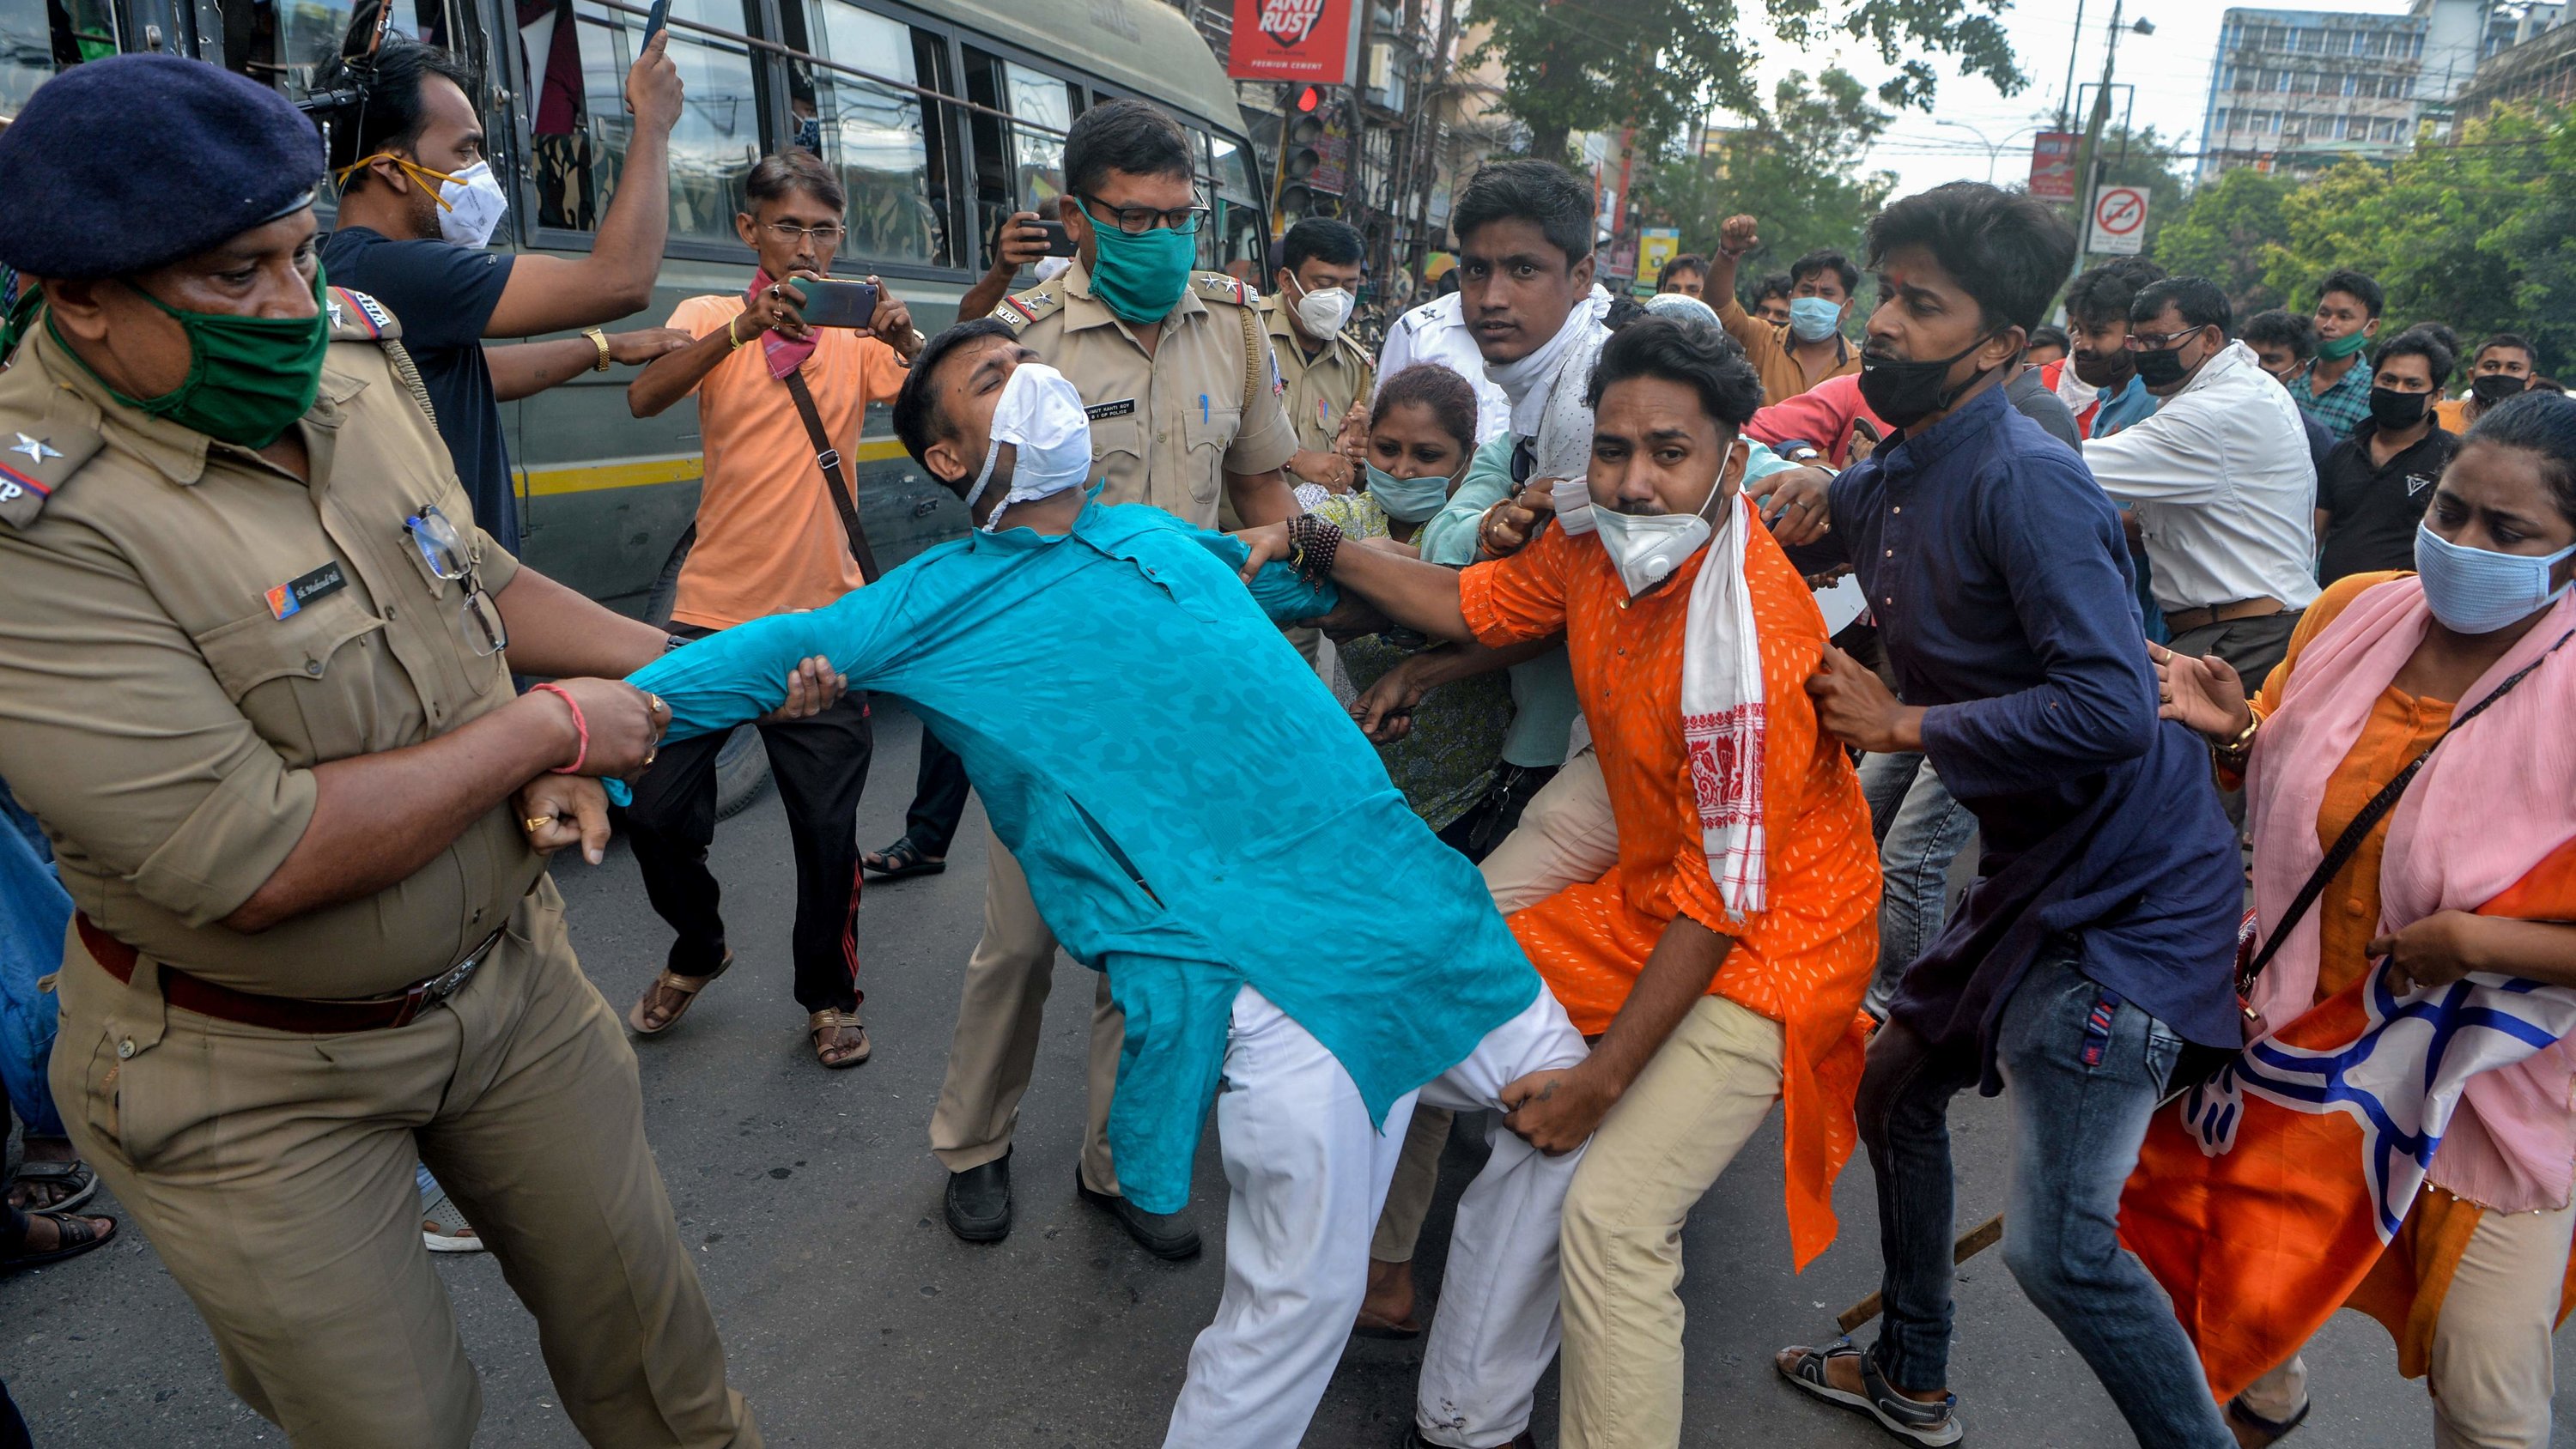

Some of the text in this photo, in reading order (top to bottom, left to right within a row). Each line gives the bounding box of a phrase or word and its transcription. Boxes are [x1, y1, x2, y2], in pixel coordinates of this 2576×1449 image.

[1258, 11, 1317, 41] RUST
[1251, 59, 1322, 70] PREMIUM CEMENT
[1248, 284, 1260, 301] WBP
[355, 292, 392, 328] WBP
[995, 305, 1020, 324] WBP
